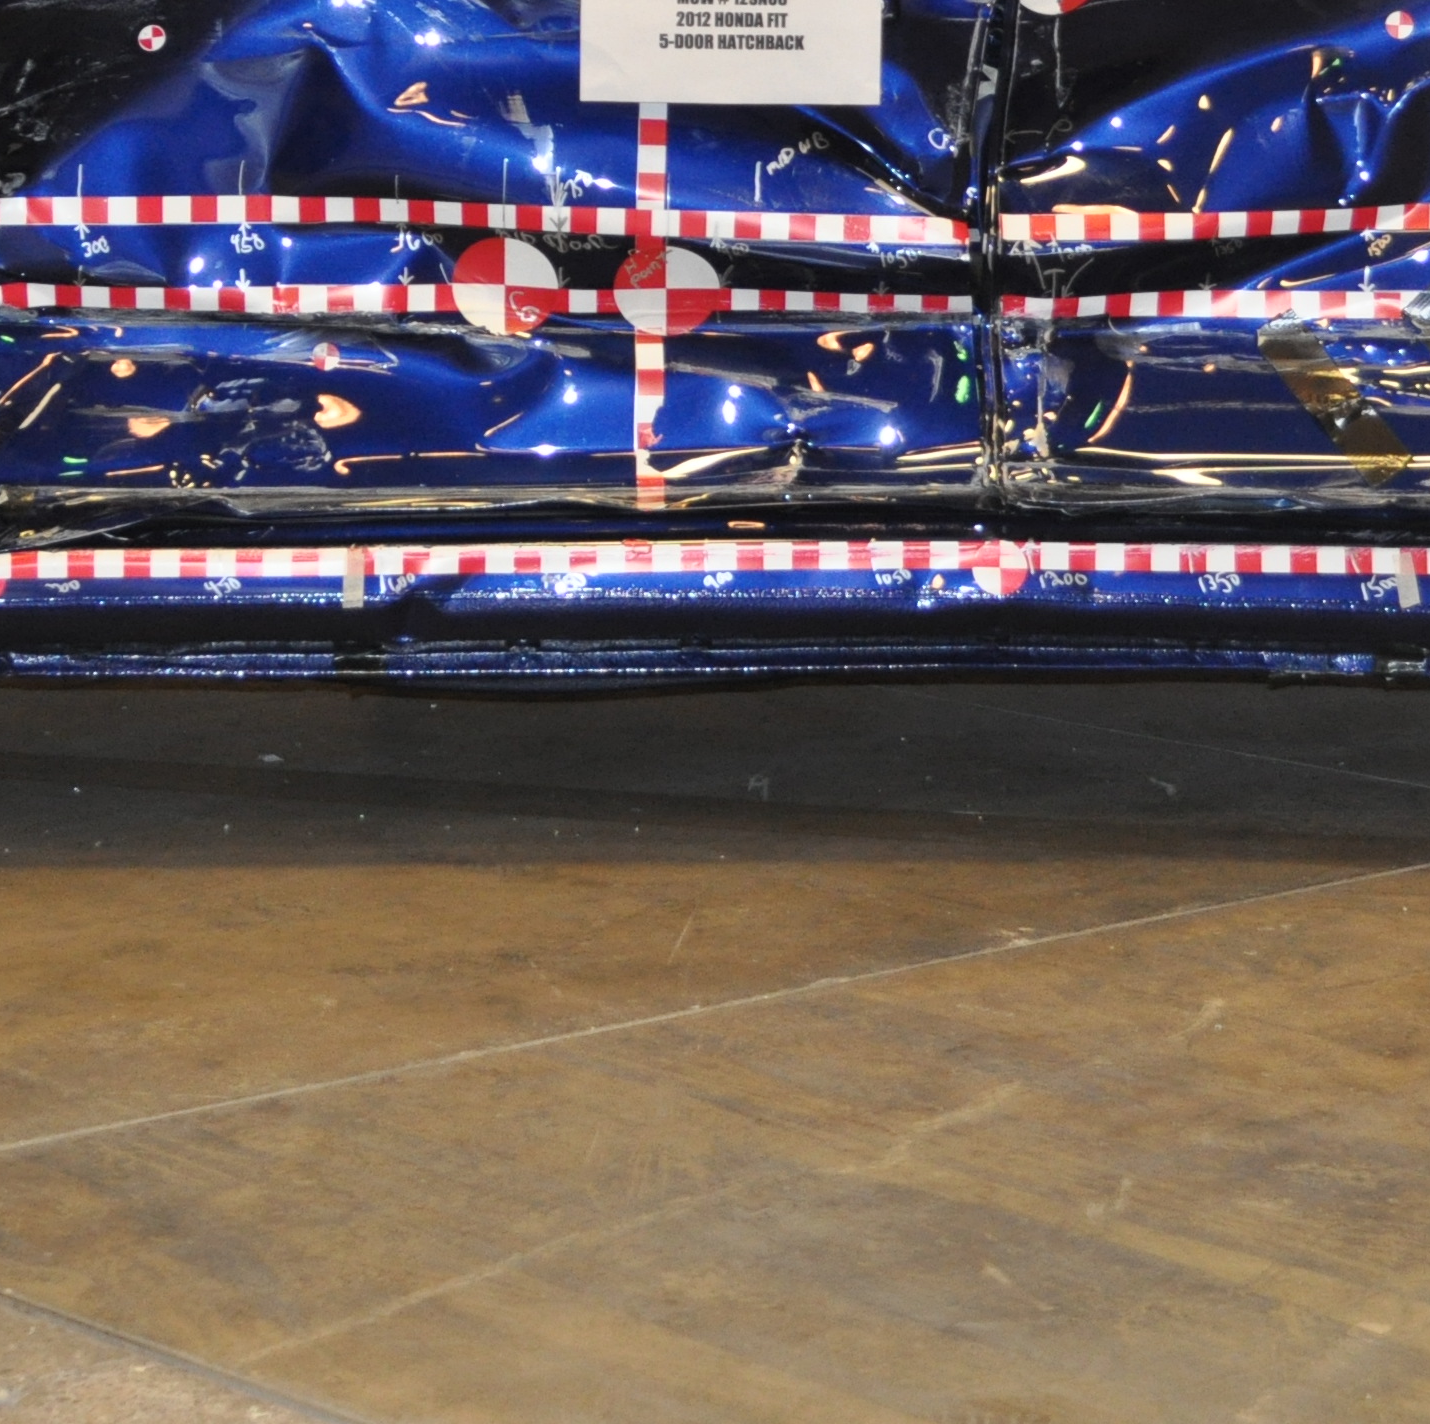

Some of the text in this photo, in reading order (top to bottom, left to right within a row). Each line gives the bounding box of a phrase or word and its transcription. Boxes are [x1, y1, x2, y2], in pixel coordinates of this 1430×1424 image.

[676, 11, 788, 29] 2012 HONDA FIT
[659, 33, 805, 51] 5-DOOR HATCHBACK
